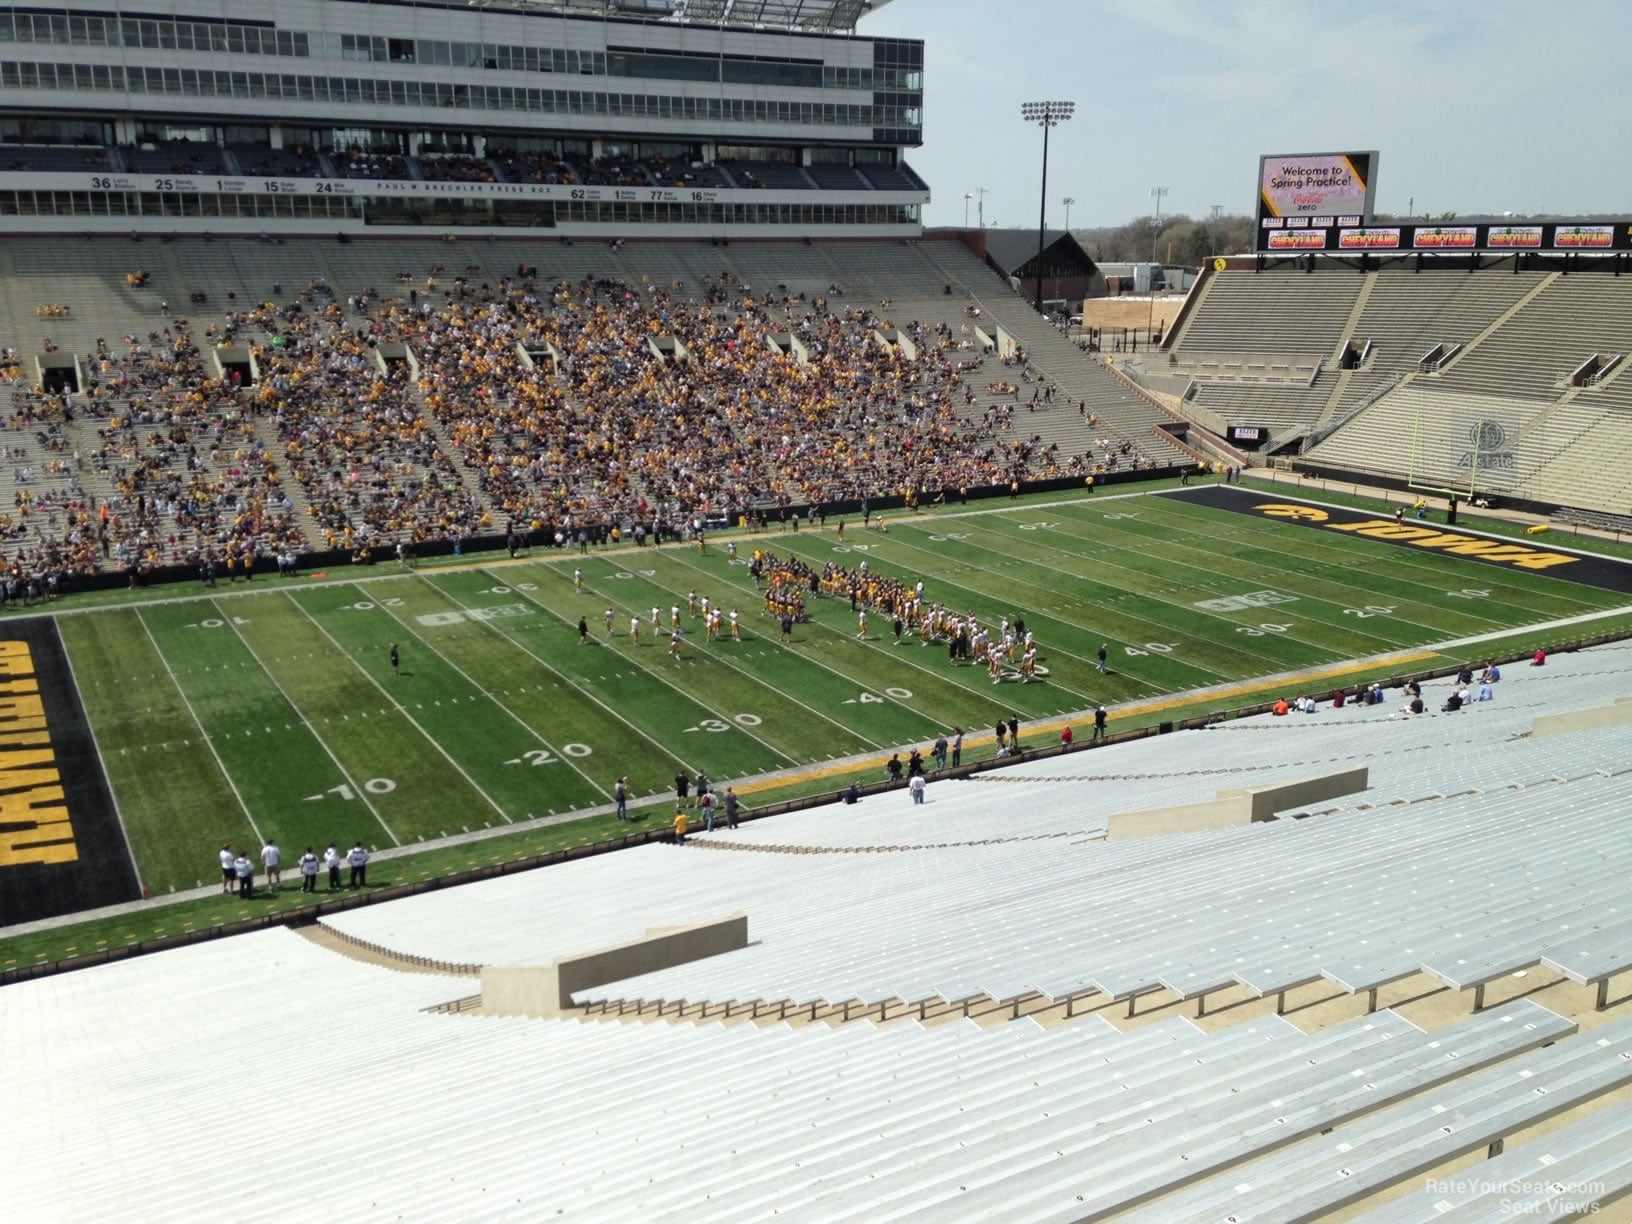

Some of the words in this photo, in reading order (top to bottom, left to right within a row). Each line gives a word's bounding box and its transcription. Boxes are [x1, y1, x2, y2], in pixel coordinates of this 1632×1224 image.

[1282, 167, 1328, 176] Welcome
[1332, 166, 1342, 175] to
[92, 177, 111, 189] 36
[155, 179, 173, 190] 25
[217, 180, 222, 191] 1
[264, 181, 279, 192] 15
[316, 182, 332, 193] 24
[1271, 178, 1303, 189] Spring
[1306, 176, 1352, 187] Practice!
[490, 185, 523, 193] PRESS
[571, 189, 585, 199] 62
[615, 190, 620, 199] 1
[650, 191, 662, 200] 77
[691, 192, 702, 201] 16
[1323, 520, 1582, 570] IOWA
[1124, 642, 1173, 656] 40
[859, 687, 913, 703] 40
[700, 713, 763, 732] 30
[522, 743, 593, 766] 20
[327, 777, 397, 800] 10
